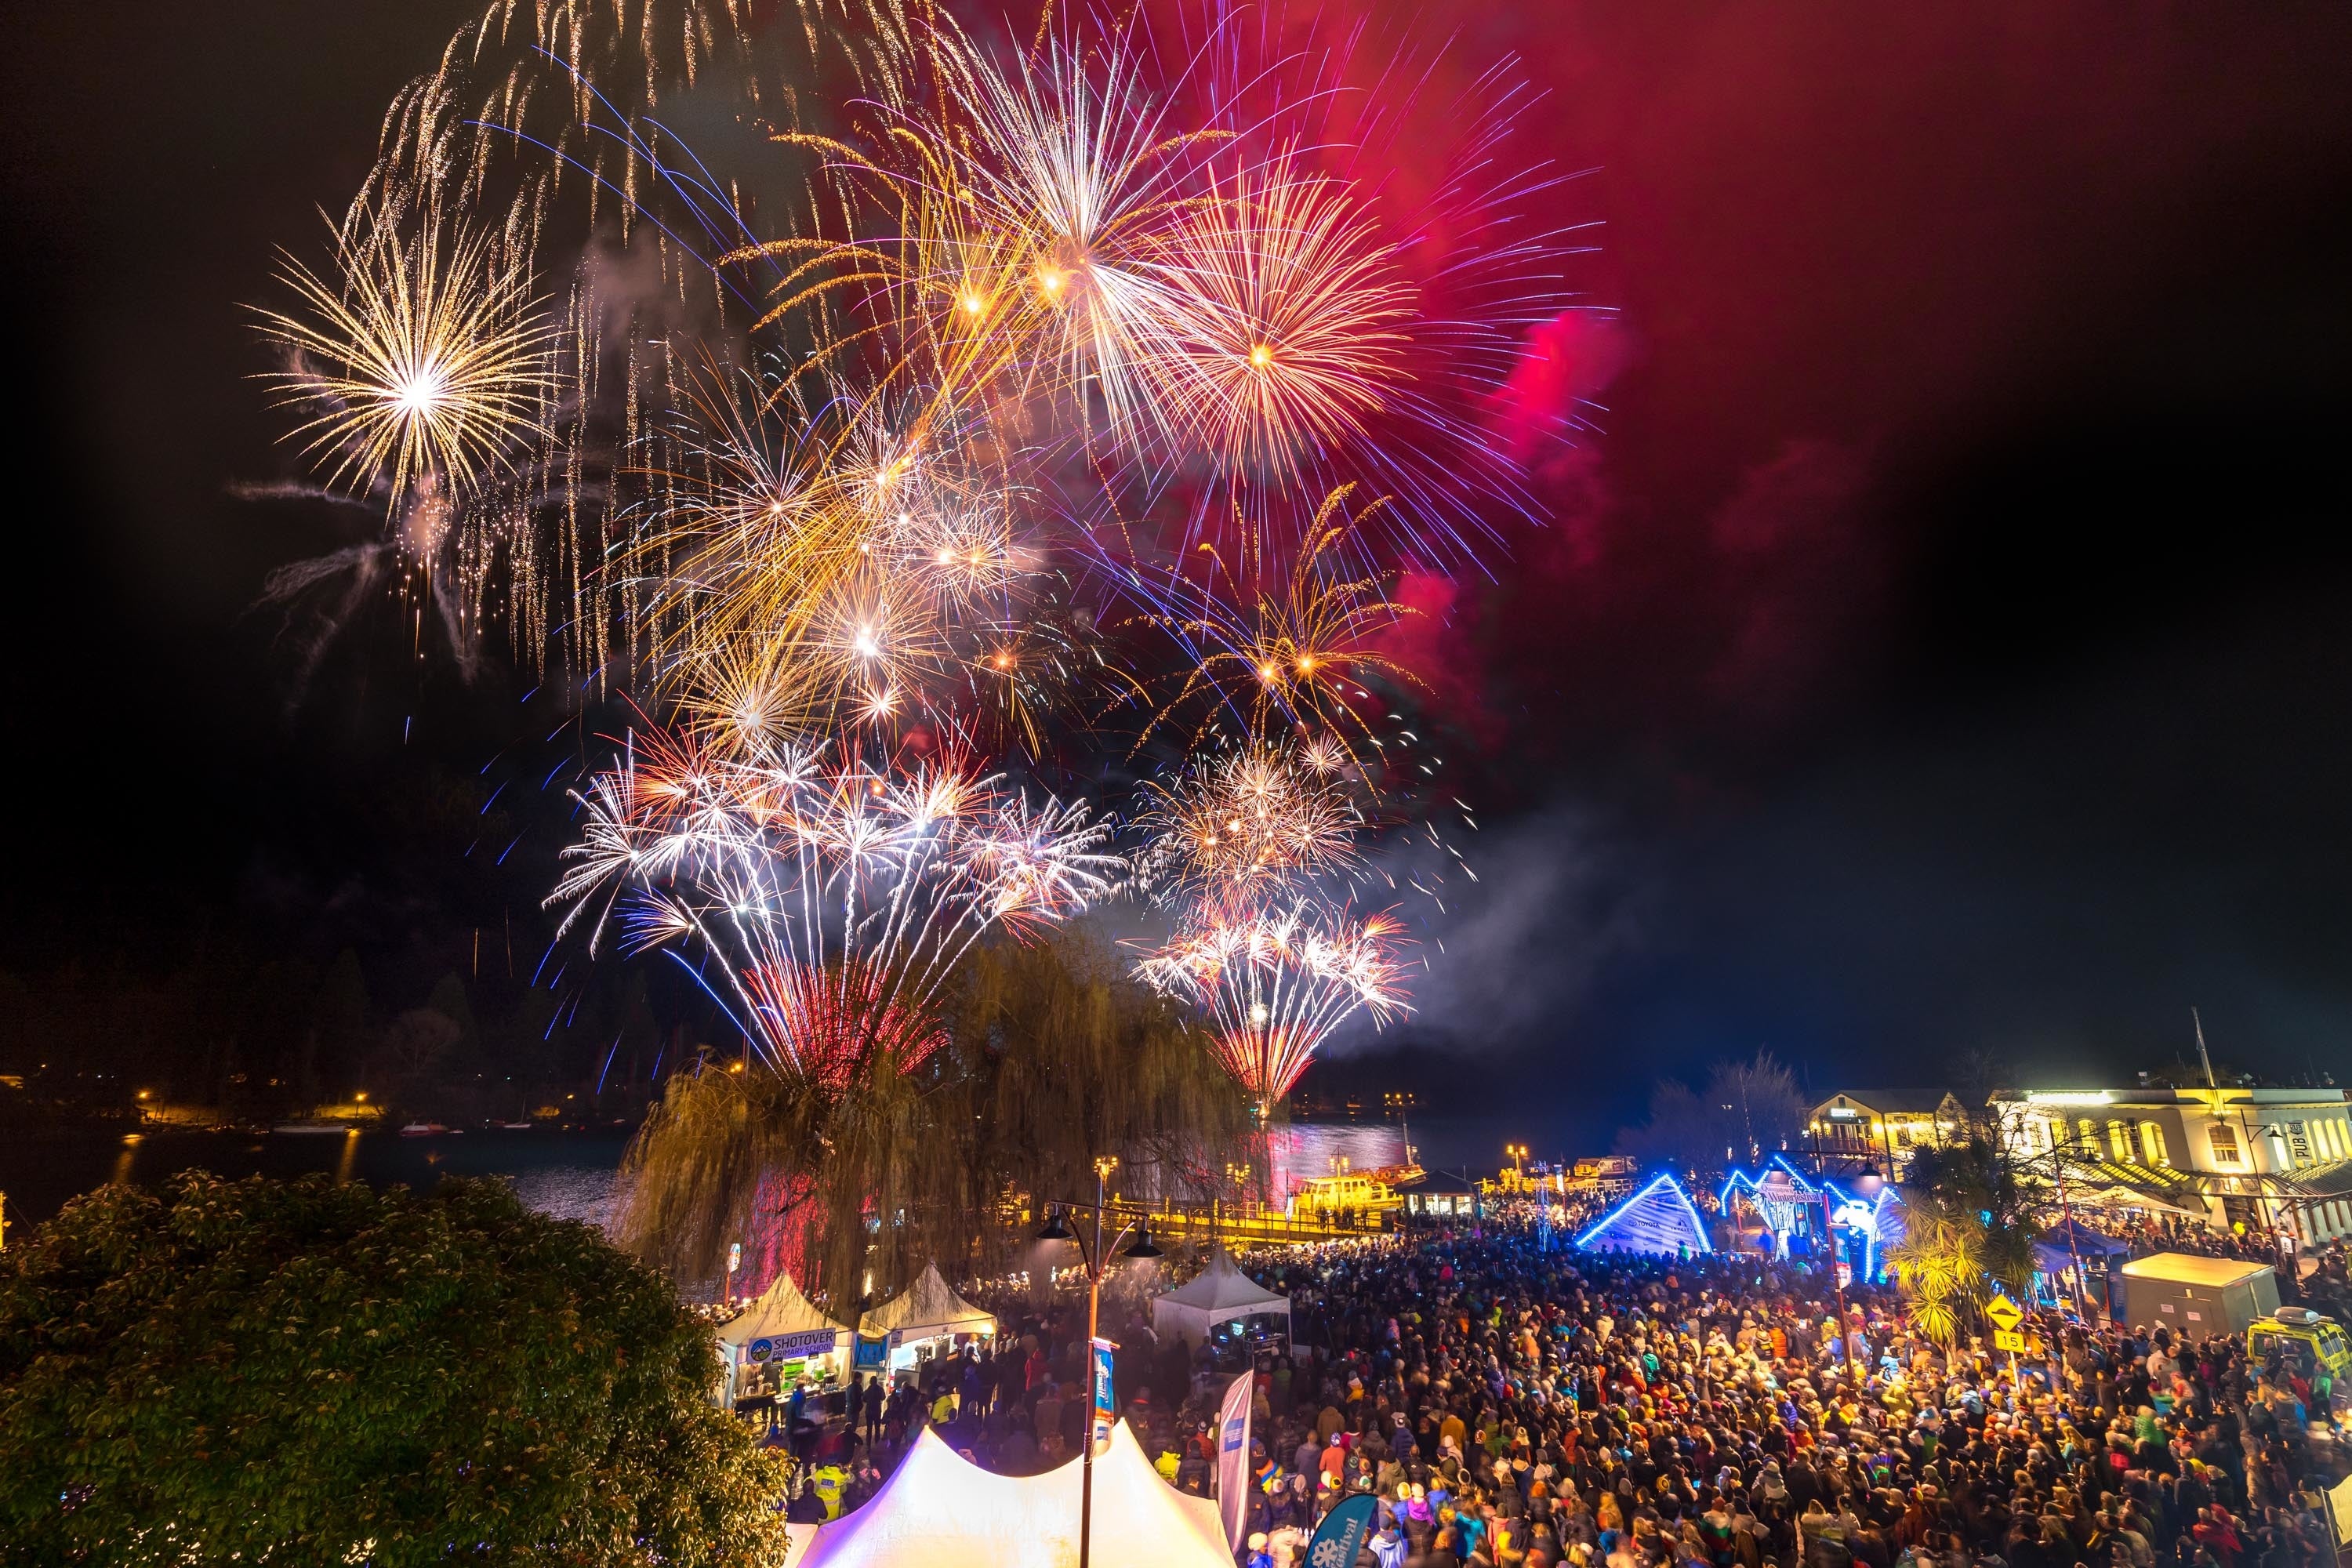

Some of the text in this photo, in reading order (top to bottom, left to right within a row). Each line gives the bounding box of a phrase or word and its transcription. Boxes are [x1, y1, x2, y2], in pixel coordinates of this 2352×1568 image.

[2292, 1138, 2309, 1157] PUB
[773, 1331, 833, 1349] SHOTOVER
[2003, 1336, 2018, 1347] 15
[773, 1343, 832, 1359] PRIMARY SCHOOL
